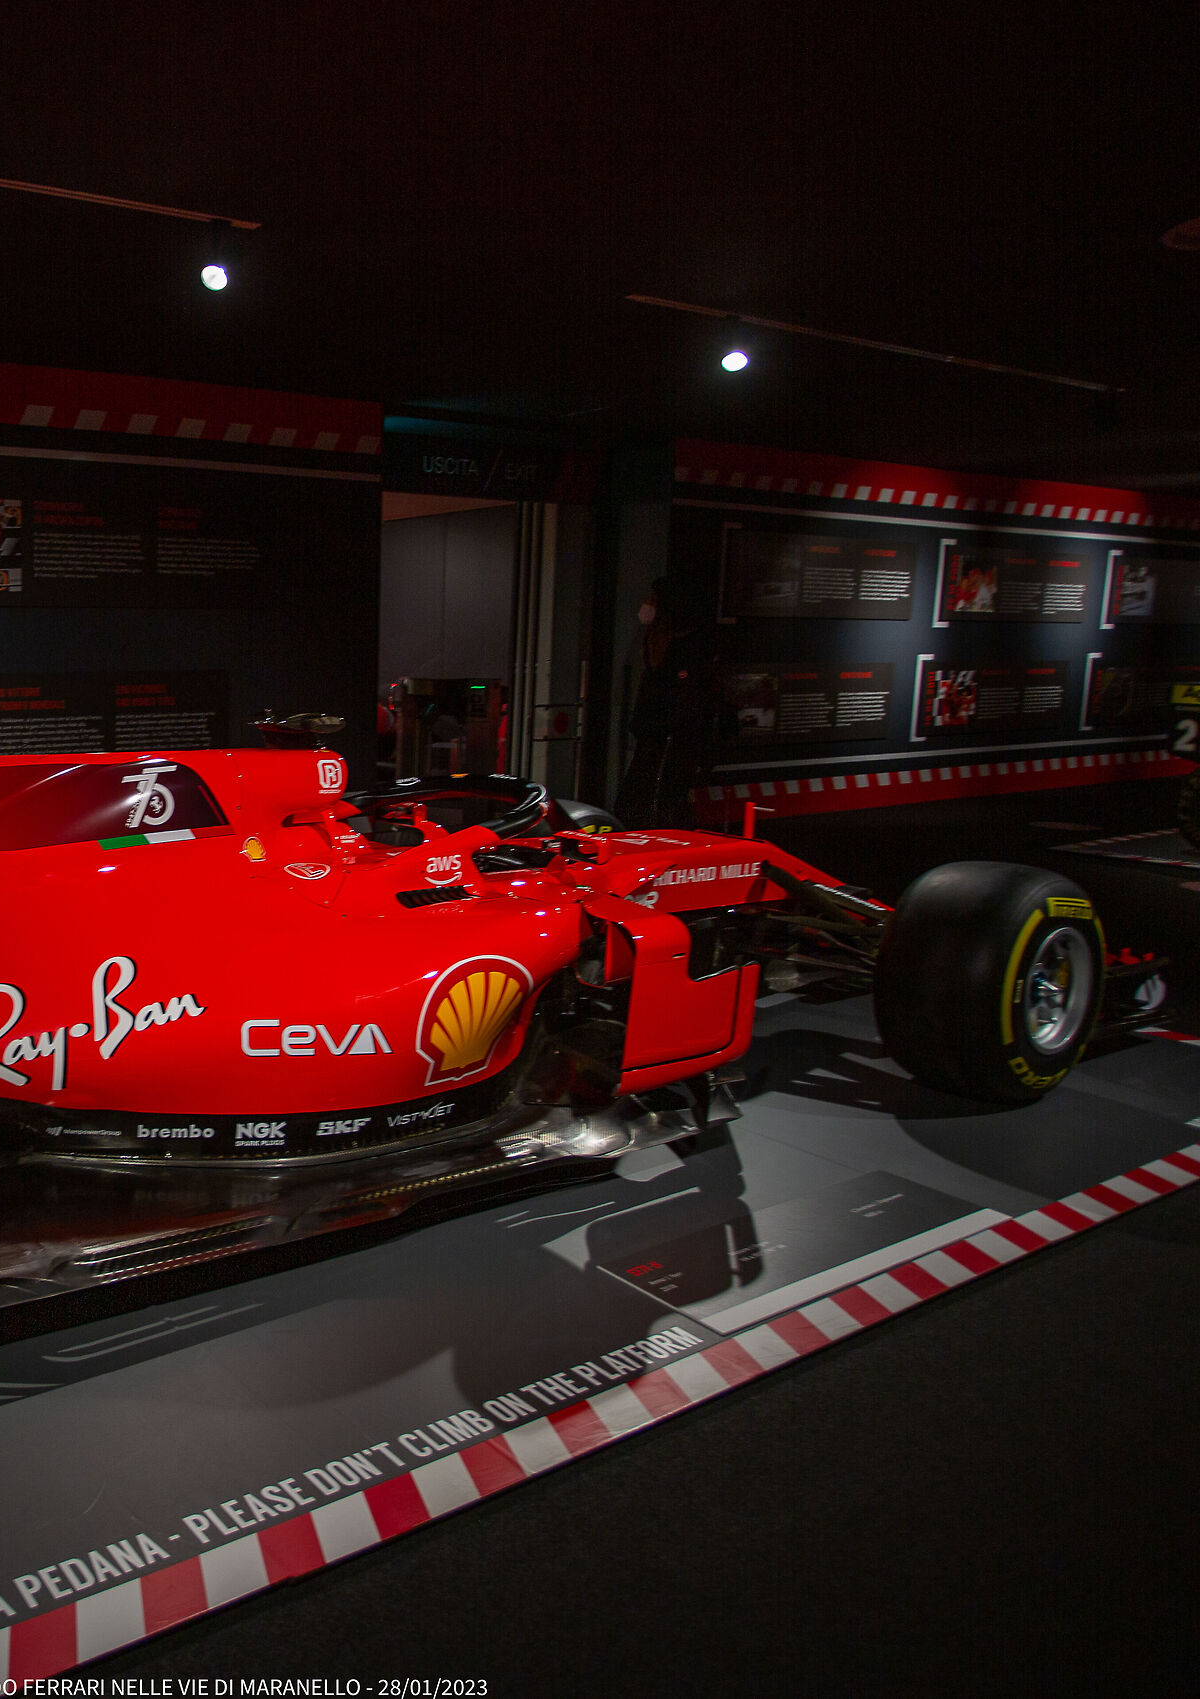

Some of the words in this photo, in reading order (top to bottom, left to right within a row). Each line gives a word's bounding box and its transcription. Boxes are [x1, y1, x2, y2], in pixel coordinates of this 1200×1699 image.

[423, 455, 480, 476] USCITA
[426, 854, 461, 873] aws
[719, 861, 761, 880] MILLE
[137, 1124, 216, 1139] brembo
[234, 1120, 288, 1140] NGK
[316, 1117, 373, 1137] SKF
[12, 1532, 171, 1608] PEDANA
[182, 1477, 316, 1544] PLEASE
[303, 1441, 406, 1496] DON'T
[397, 1408, 496, 1458] CLIMB
[482, 1392, 538, 1423] ON
[521, 1371, 590, 1406] THE
[570, 1326, 705, 1387] PLATFORM
